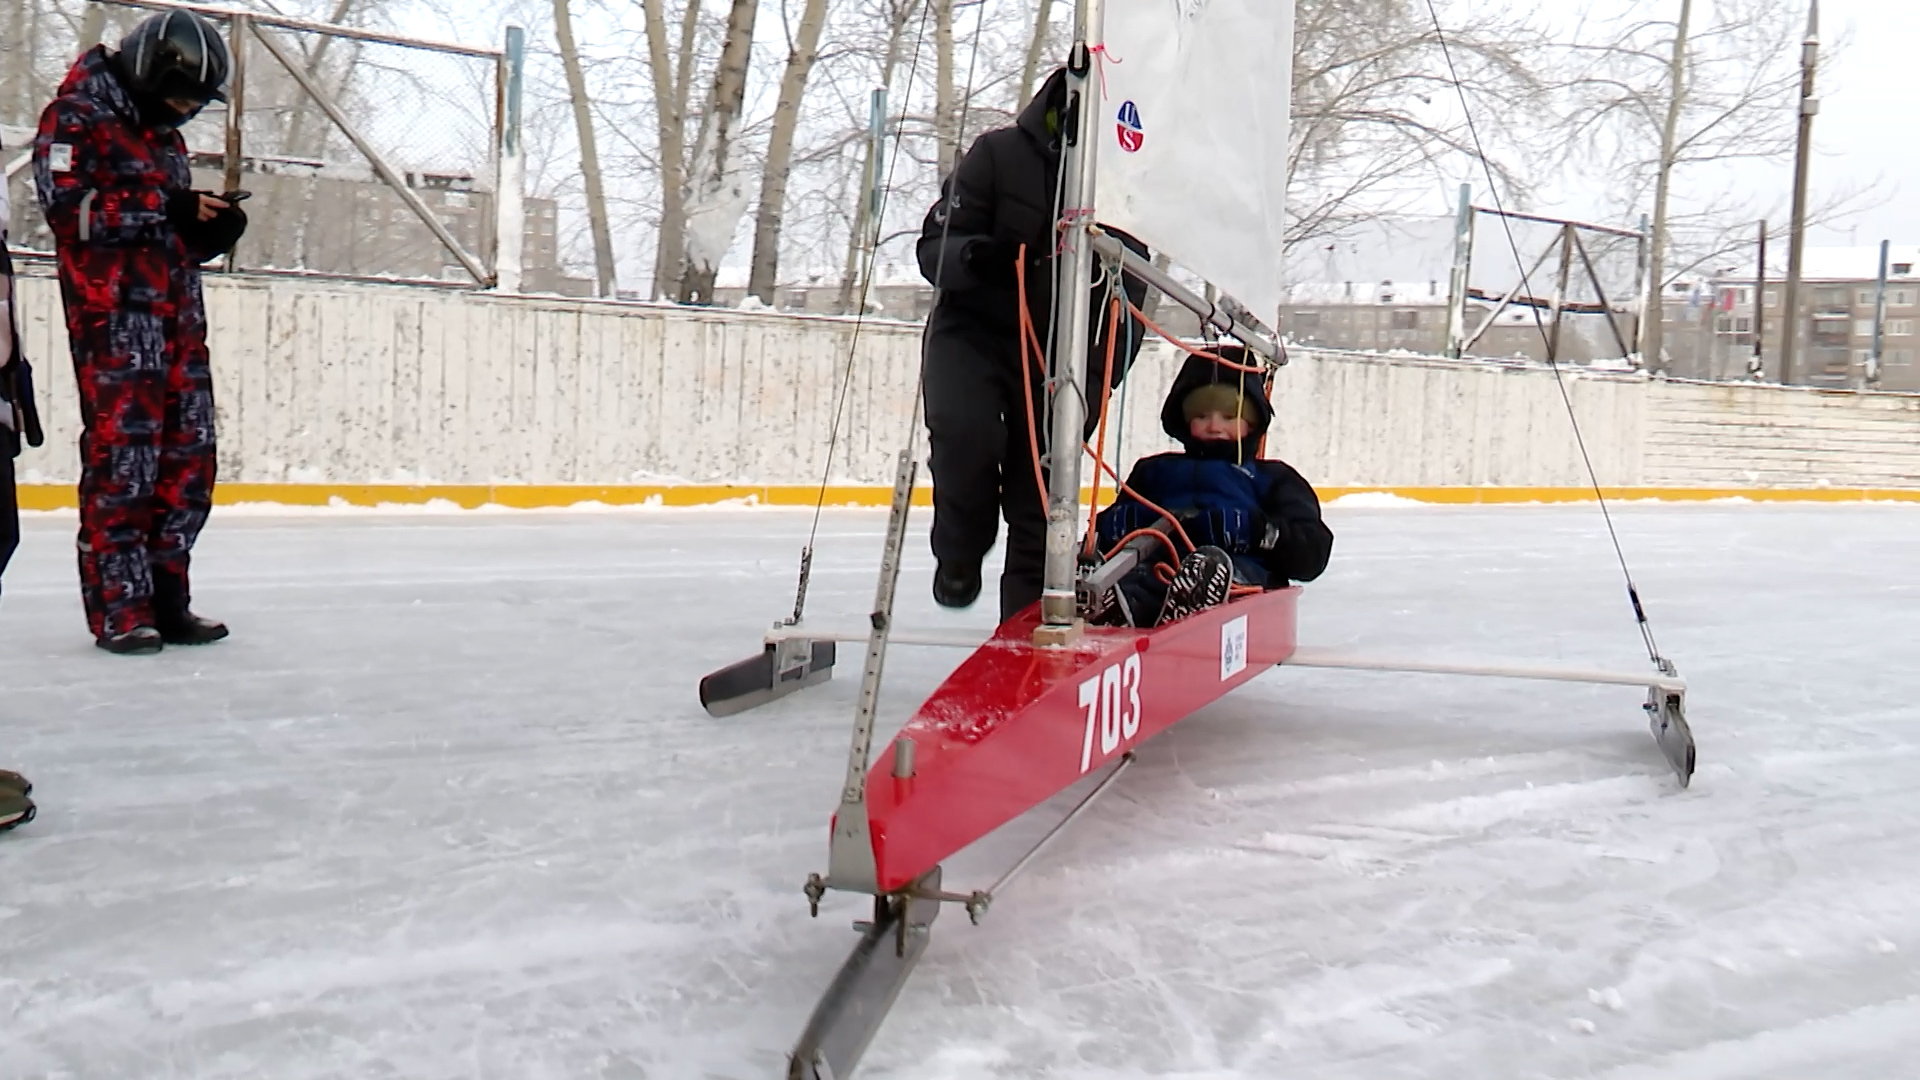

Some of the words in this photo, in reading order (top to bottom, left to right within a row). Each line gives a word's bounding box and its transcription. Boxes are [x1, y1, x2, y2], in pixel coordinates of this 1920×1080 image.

[1124, 103, 1137, 125] U
[1122, 129, 1136, 151] S
[1078, 652, 1141, 774] 703
